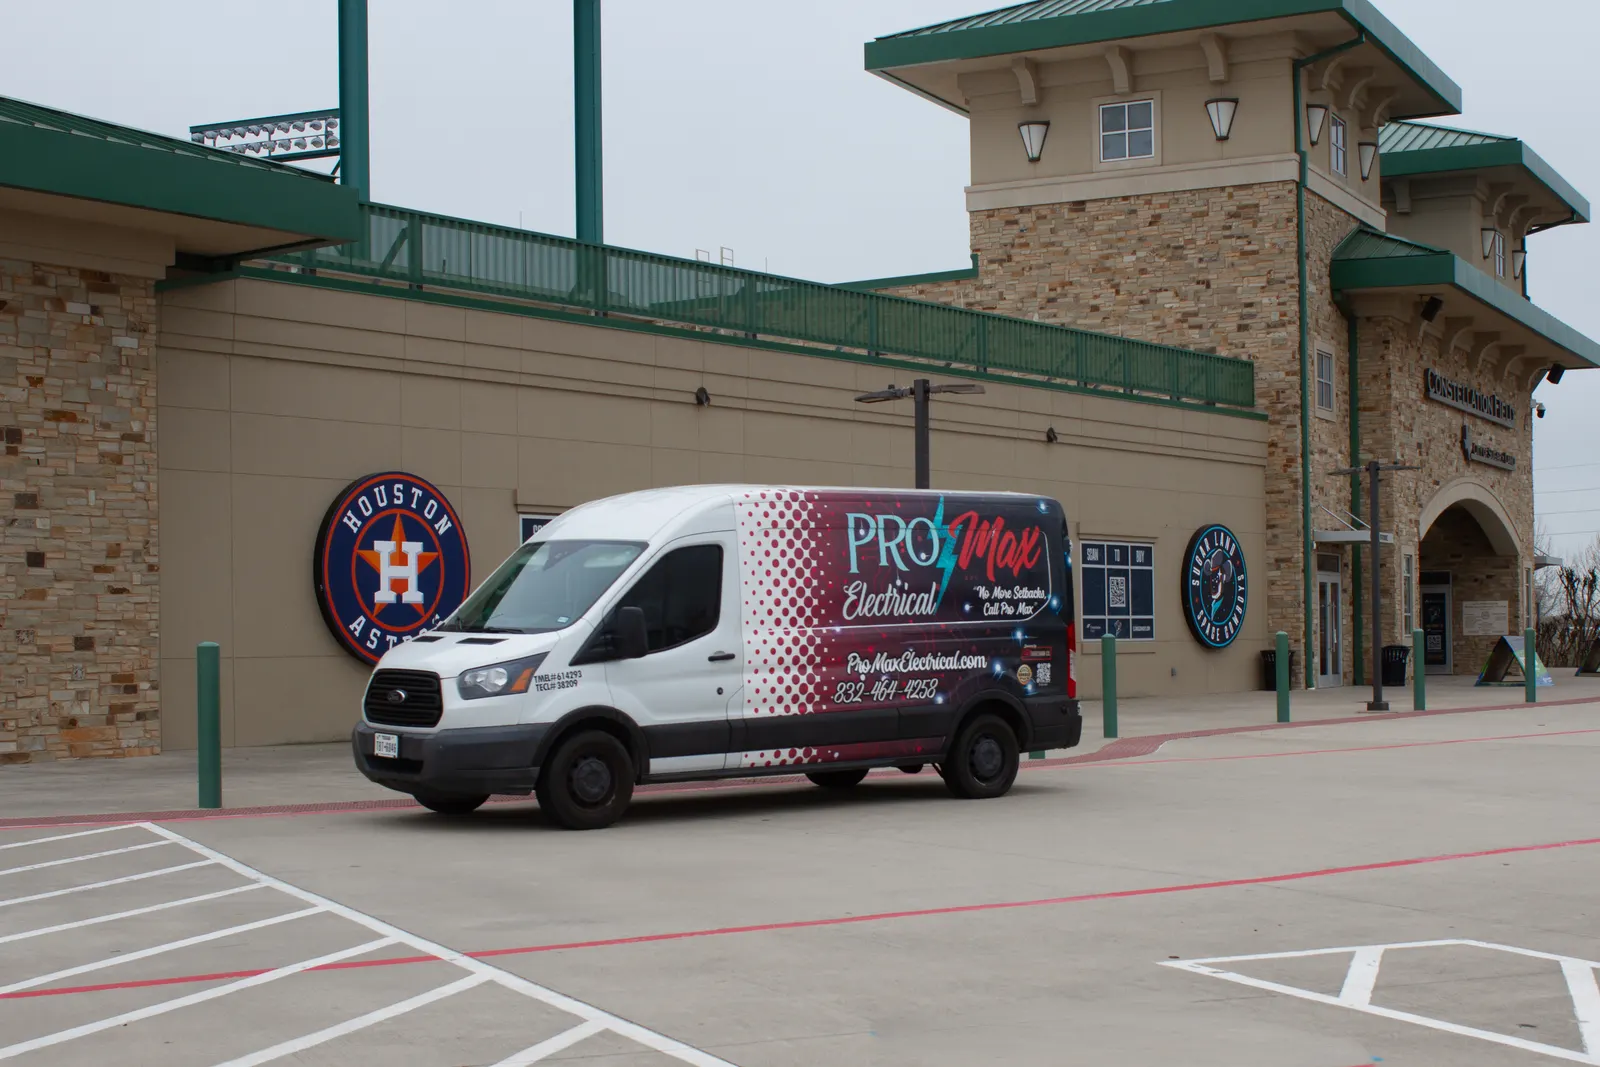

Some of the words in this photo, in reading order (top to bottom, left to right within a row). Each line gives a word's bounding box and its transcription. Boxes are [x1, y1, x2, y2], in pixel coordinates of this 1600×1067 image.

[343, 483, 452, 535] HOUSTON
[374, 540, 424, 603] H
[846, 512, 939, 573] PRO
[948, 510, 1041, 582] Max
[1192, 537, 1210, 586] SUGAR
[1214, 531, 1236, 557] LAND
[842, 580, 937, 620] Electrical
[983, 602, 1000, 616] Call
[1000, 601, 1015, 615] Pro
[991, 585, 1012, 600] More
[1013, 585, 1047, 600] Setbacks,
[1197, 610, 1220, 641] SPACE
[1224, 574, 1245, 639] COWBOYS
[833, 678, 939, 703] 832-464-4258
